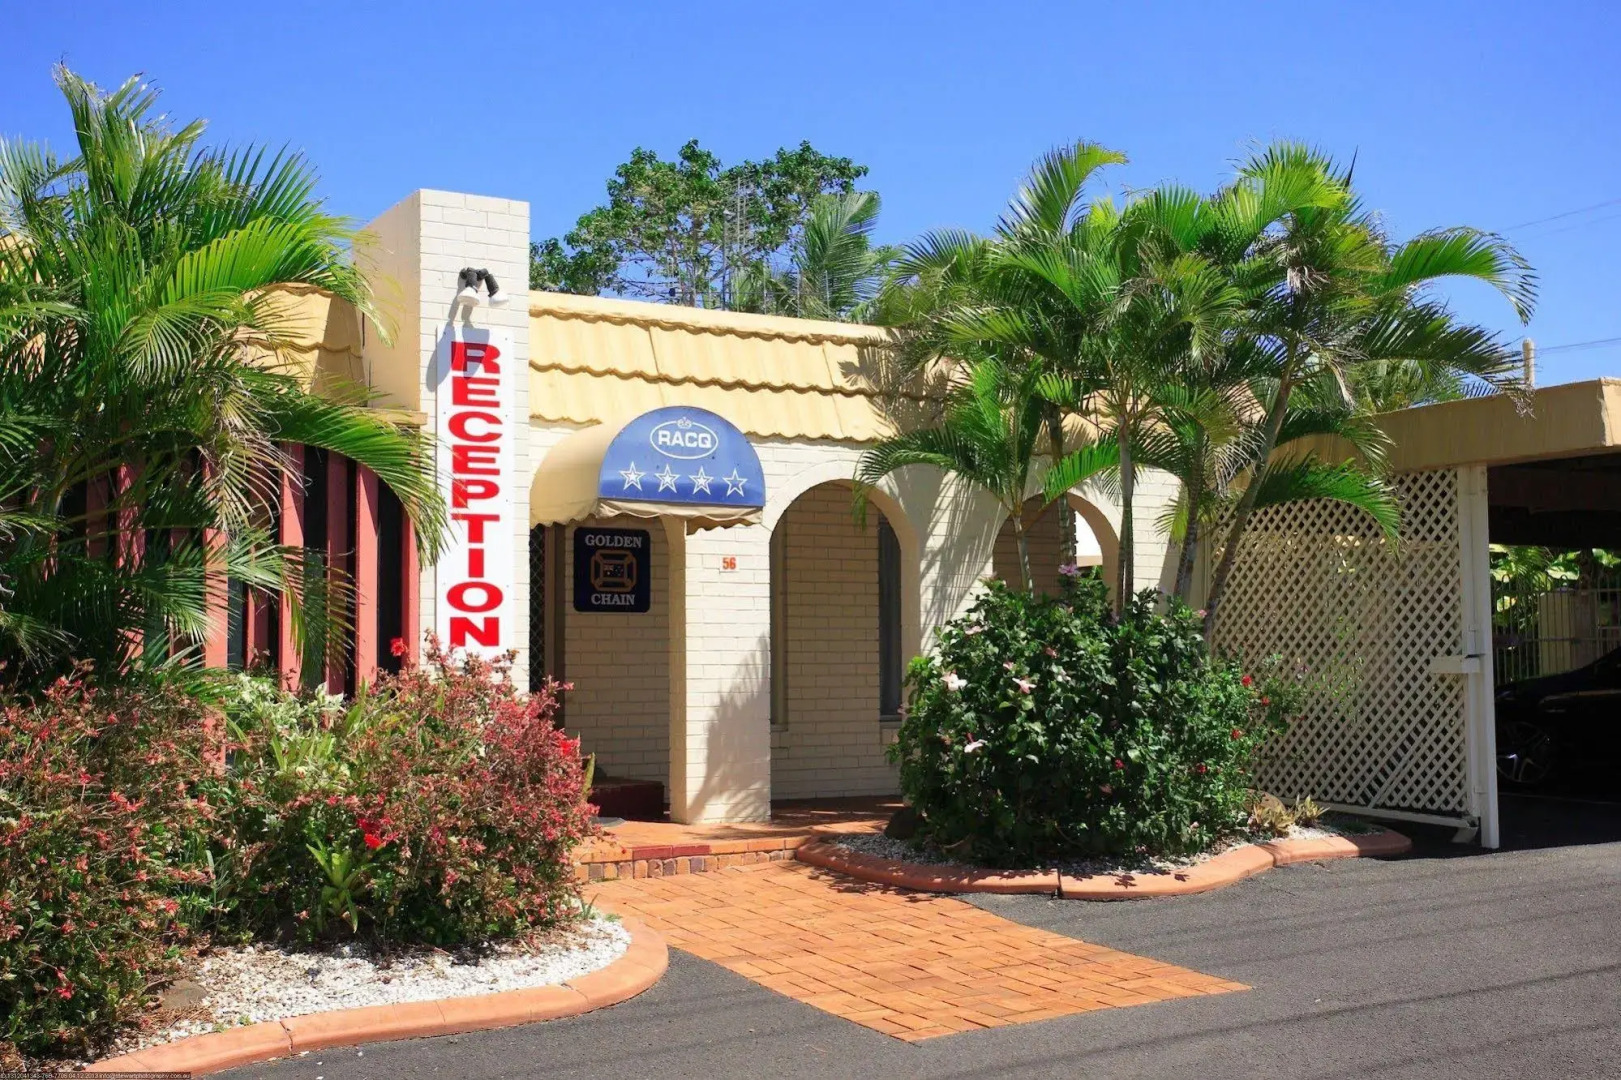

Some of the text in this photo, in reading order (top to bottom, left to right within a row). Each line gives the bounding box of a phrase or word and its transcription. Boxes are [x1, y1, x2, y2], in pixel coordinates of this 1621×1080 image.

[658, 430, 712, 449] RACQ
[446, 341, 504, 647] RECEPTION
[584, 534, 643, 548] GOLDEN
[722, 557, 737, 570] 56
[591, 593, 636, 606] CHAIN
